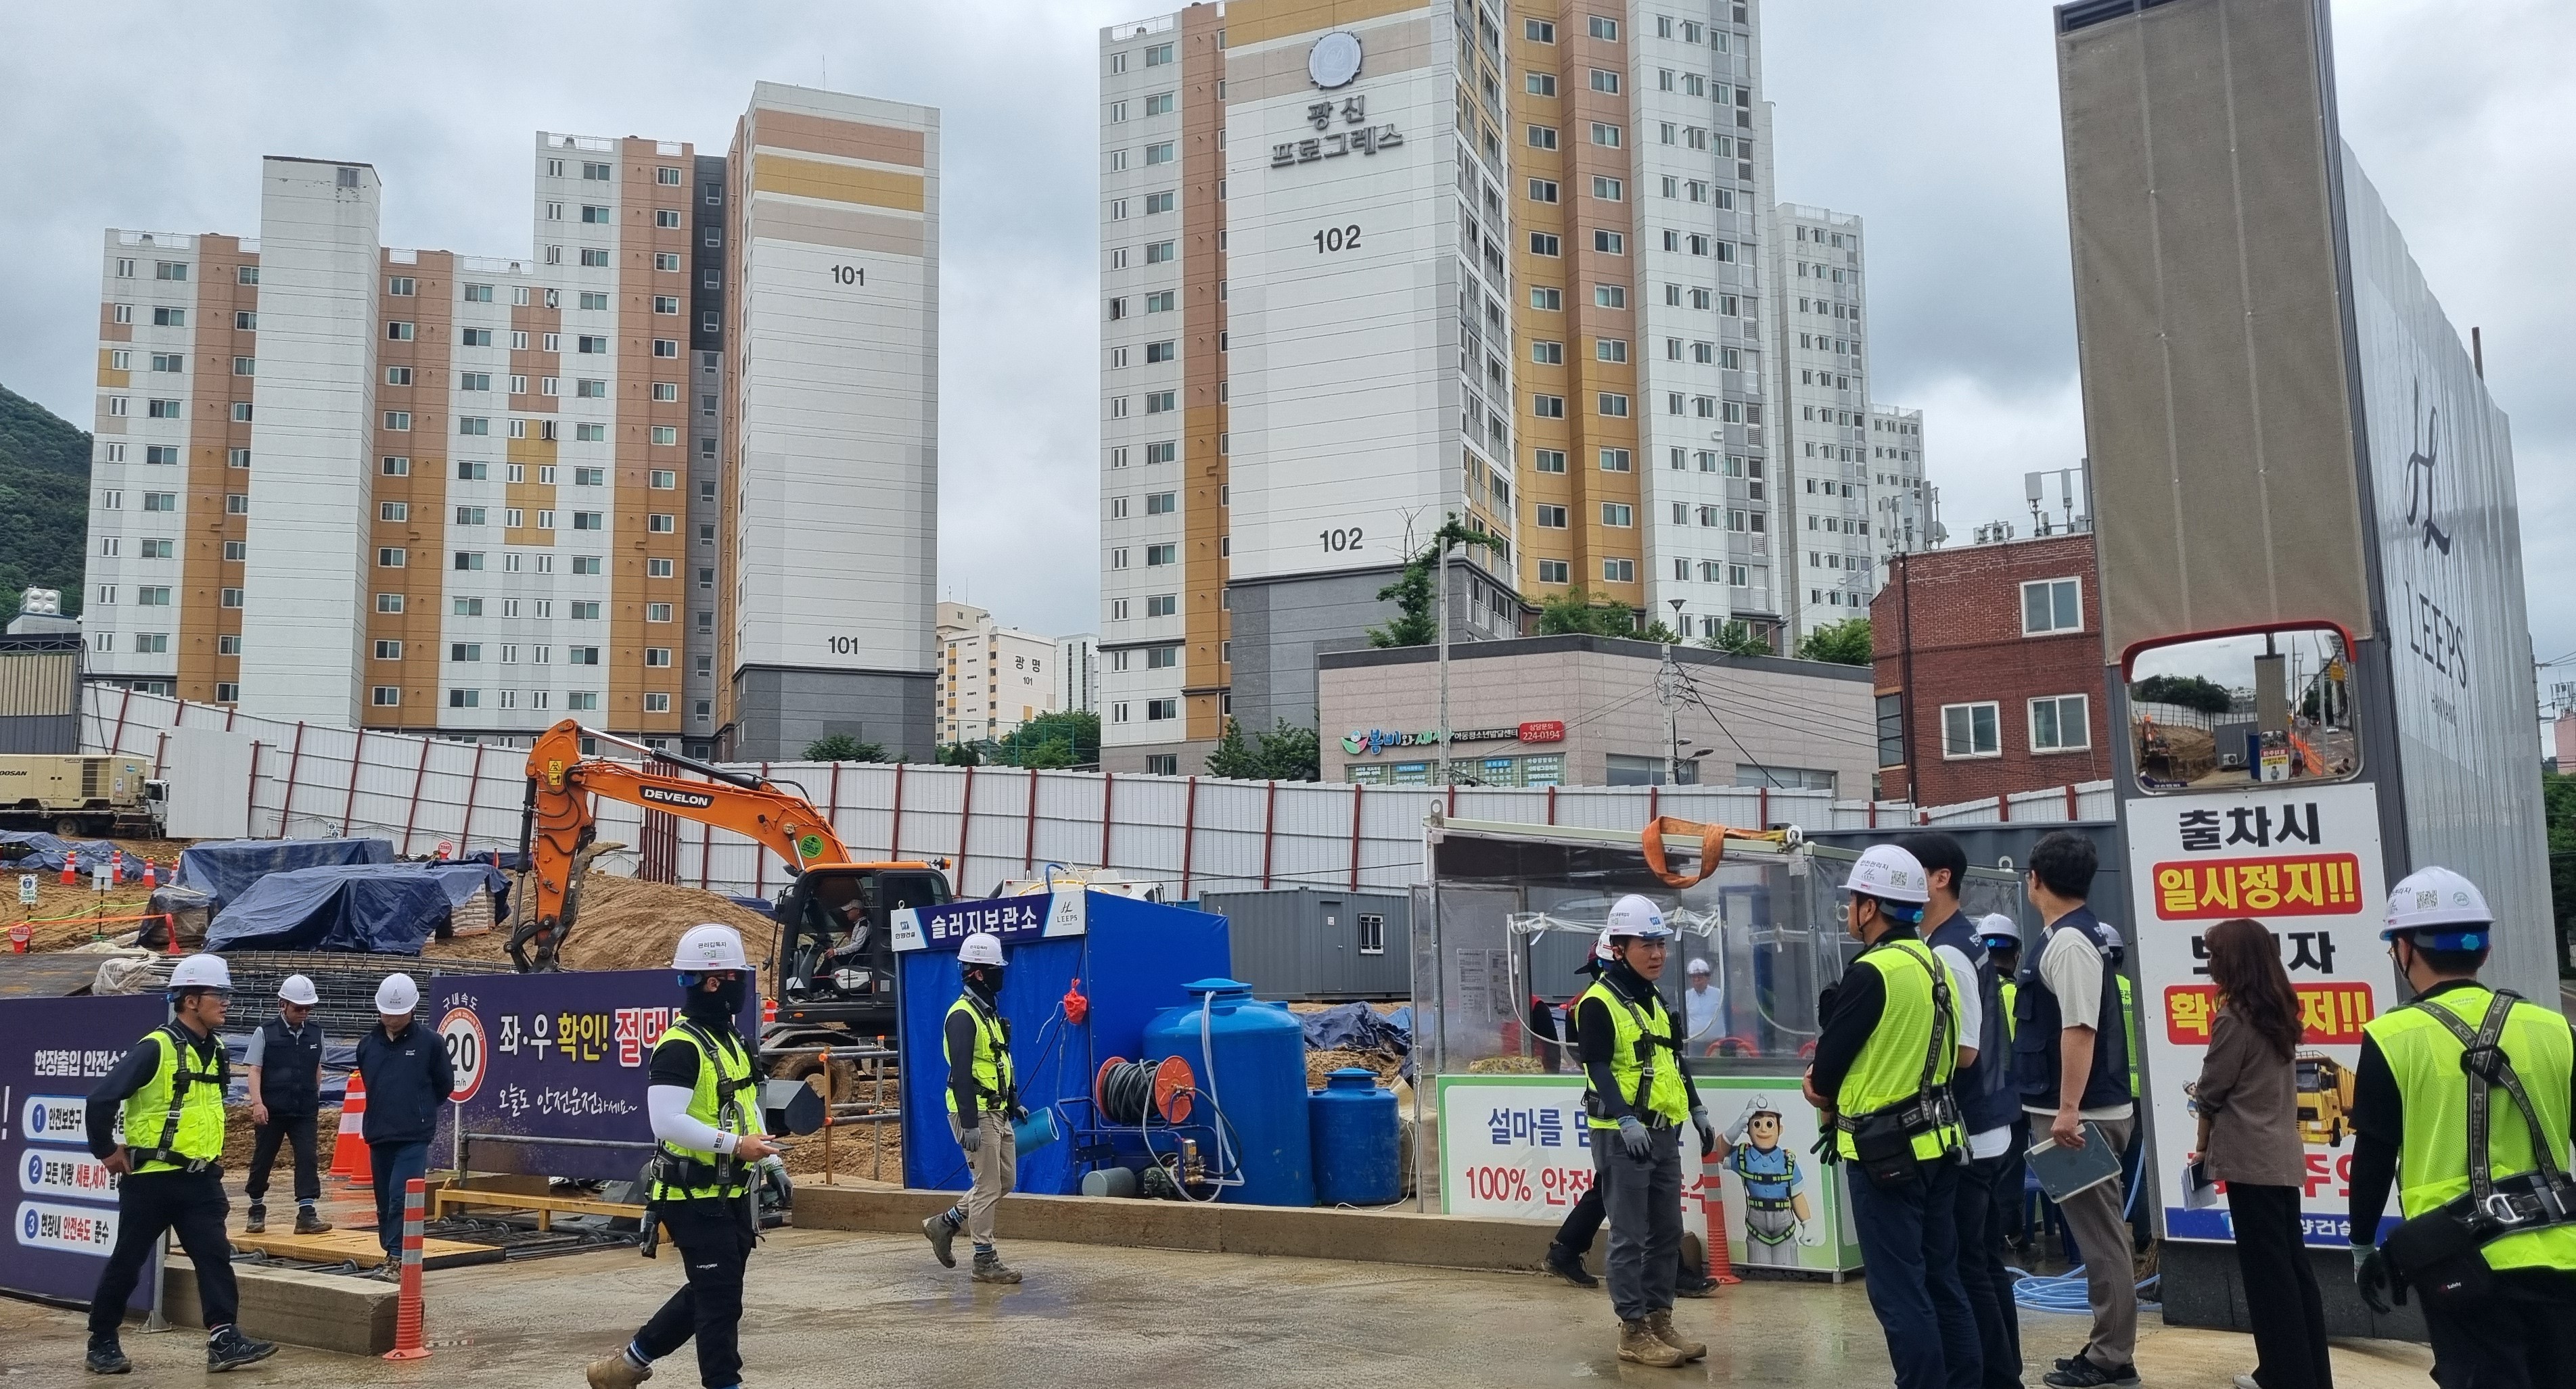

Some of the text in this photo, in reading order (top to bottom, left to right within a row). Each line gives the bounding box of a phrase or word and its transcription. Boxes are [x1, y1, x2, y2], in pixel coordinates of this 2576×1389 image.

[1307, 94, 1365, 130] 광신
[1270, 124, 1403, 168] 프로그레스
[1313, 225, 1362, 254] 102
[830, 264, 865, 287] 101
[1319, 527, 1364, 552] 102
[827, 636, 860, 655] 101
[2405, 580, 2467, 690] LEEPS
[1015, 655, 1040, 673] 광명
[1023, 676, 1033, 686] 101
[1368, 728, 1415, 755] 봄비와
[1523, 730, 1561, 741] 224-0194
[644, 788, 708, 806] DEVELON
[2179, 802, 2321, 852] 출차시
[2159, 862, 2355, 912] 일시정지!!
[931, 905, 1038, 939] 슬러지보관소
[1057, 914, 1078, 922] LEEPS
[442, 992, 478, 1010] 구내속도
[2170, 990, 2368, 1036] 확저!!
[557, 1012, 608, 1062] 확인!
[34, 1050, 128, 1077] 현장출입 안전수
[444, 1033, 476, 1073] 20
[453, 1078, 467, 1087] m/h
[499, 1082, 531, 1117] 오늘도
[49, 1108, 82, 1132] 안전보호구
[1488, 1107, 1563, 1148] 설마를
[45, 1161, 59, 1185] 모든
[60, 1162, 74, 1186] 차량
[1465, 1167, 1532, 1202] 100%
[41, 1213, 62, 1239] 현장내
[64, 1216, 91, 1242] 안전속도
[95, 1220, 110, 1246] 준수
